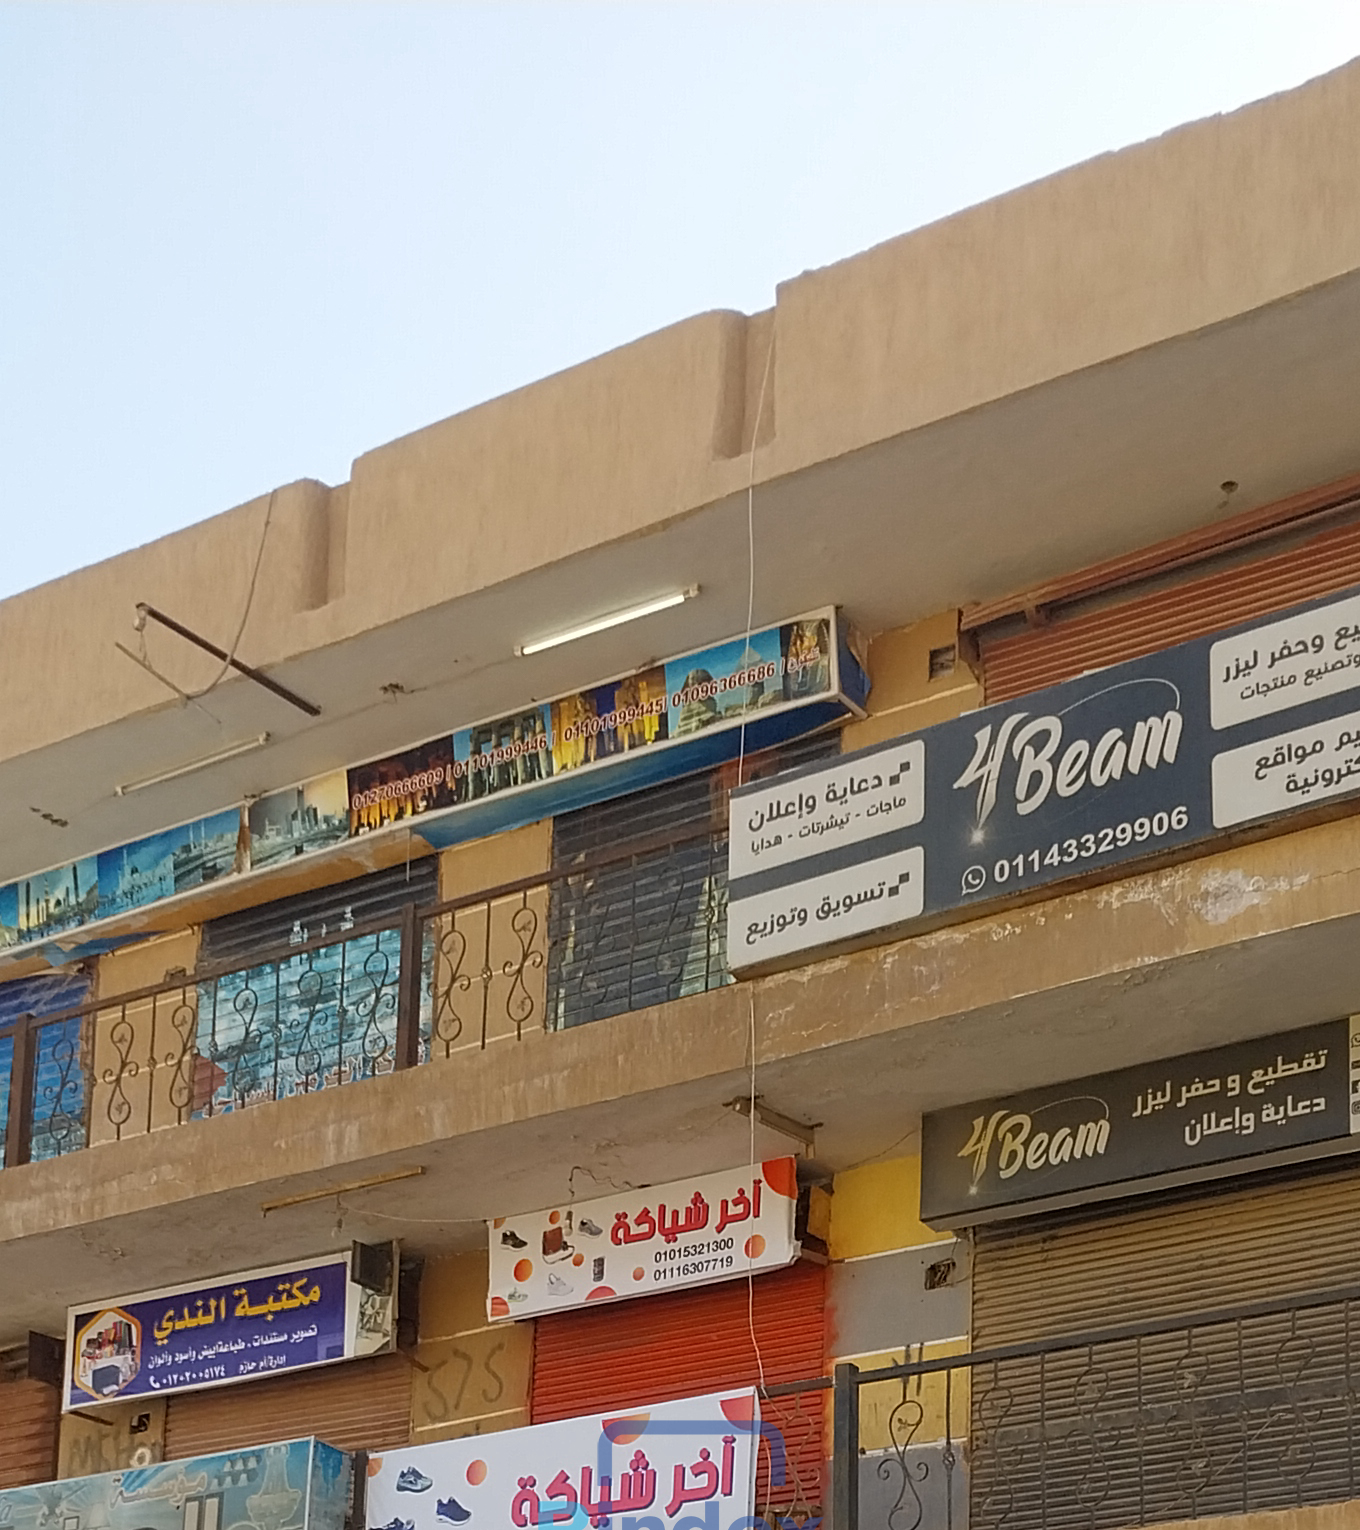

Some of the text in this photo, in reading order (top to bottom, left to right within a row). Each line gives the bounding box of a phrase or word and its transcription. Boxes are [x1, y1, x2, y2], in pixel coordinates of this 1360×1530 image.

[1223, 650, 1259, 683] ليزر
[1267, 634, 1325, 669] وحفر
[1240, 675, 1297, 700] منتجات
[1255, 740, 1325, 780] مواقع
[748, 774, 883, 832] دعاية وإعلان
[751, 796, 906, 855] ماجات تيشرتات هدايا
[994, 806, 1189, 883] 01143329906
[745, 881, 886, 945] تسويق وتوزيع
[1132, 1049, 1328, 1118] تقطيع و حفر ليزر
[1184, 1096, 1326, 1146] دعاية وإعلان
[610, 1191, 709, 1246] شياكة
[653, 1255, 734, 1281] 01116307719
[654, 1237, 734, 1263] 01015321300
[153, 1277, 321, 1346] مكتبة الندي
[290, 1324, 318, 1343] تصوير
[253, 1331, 288, 1347] مستندات
[511, 1449, 657, 1529] شياكة
